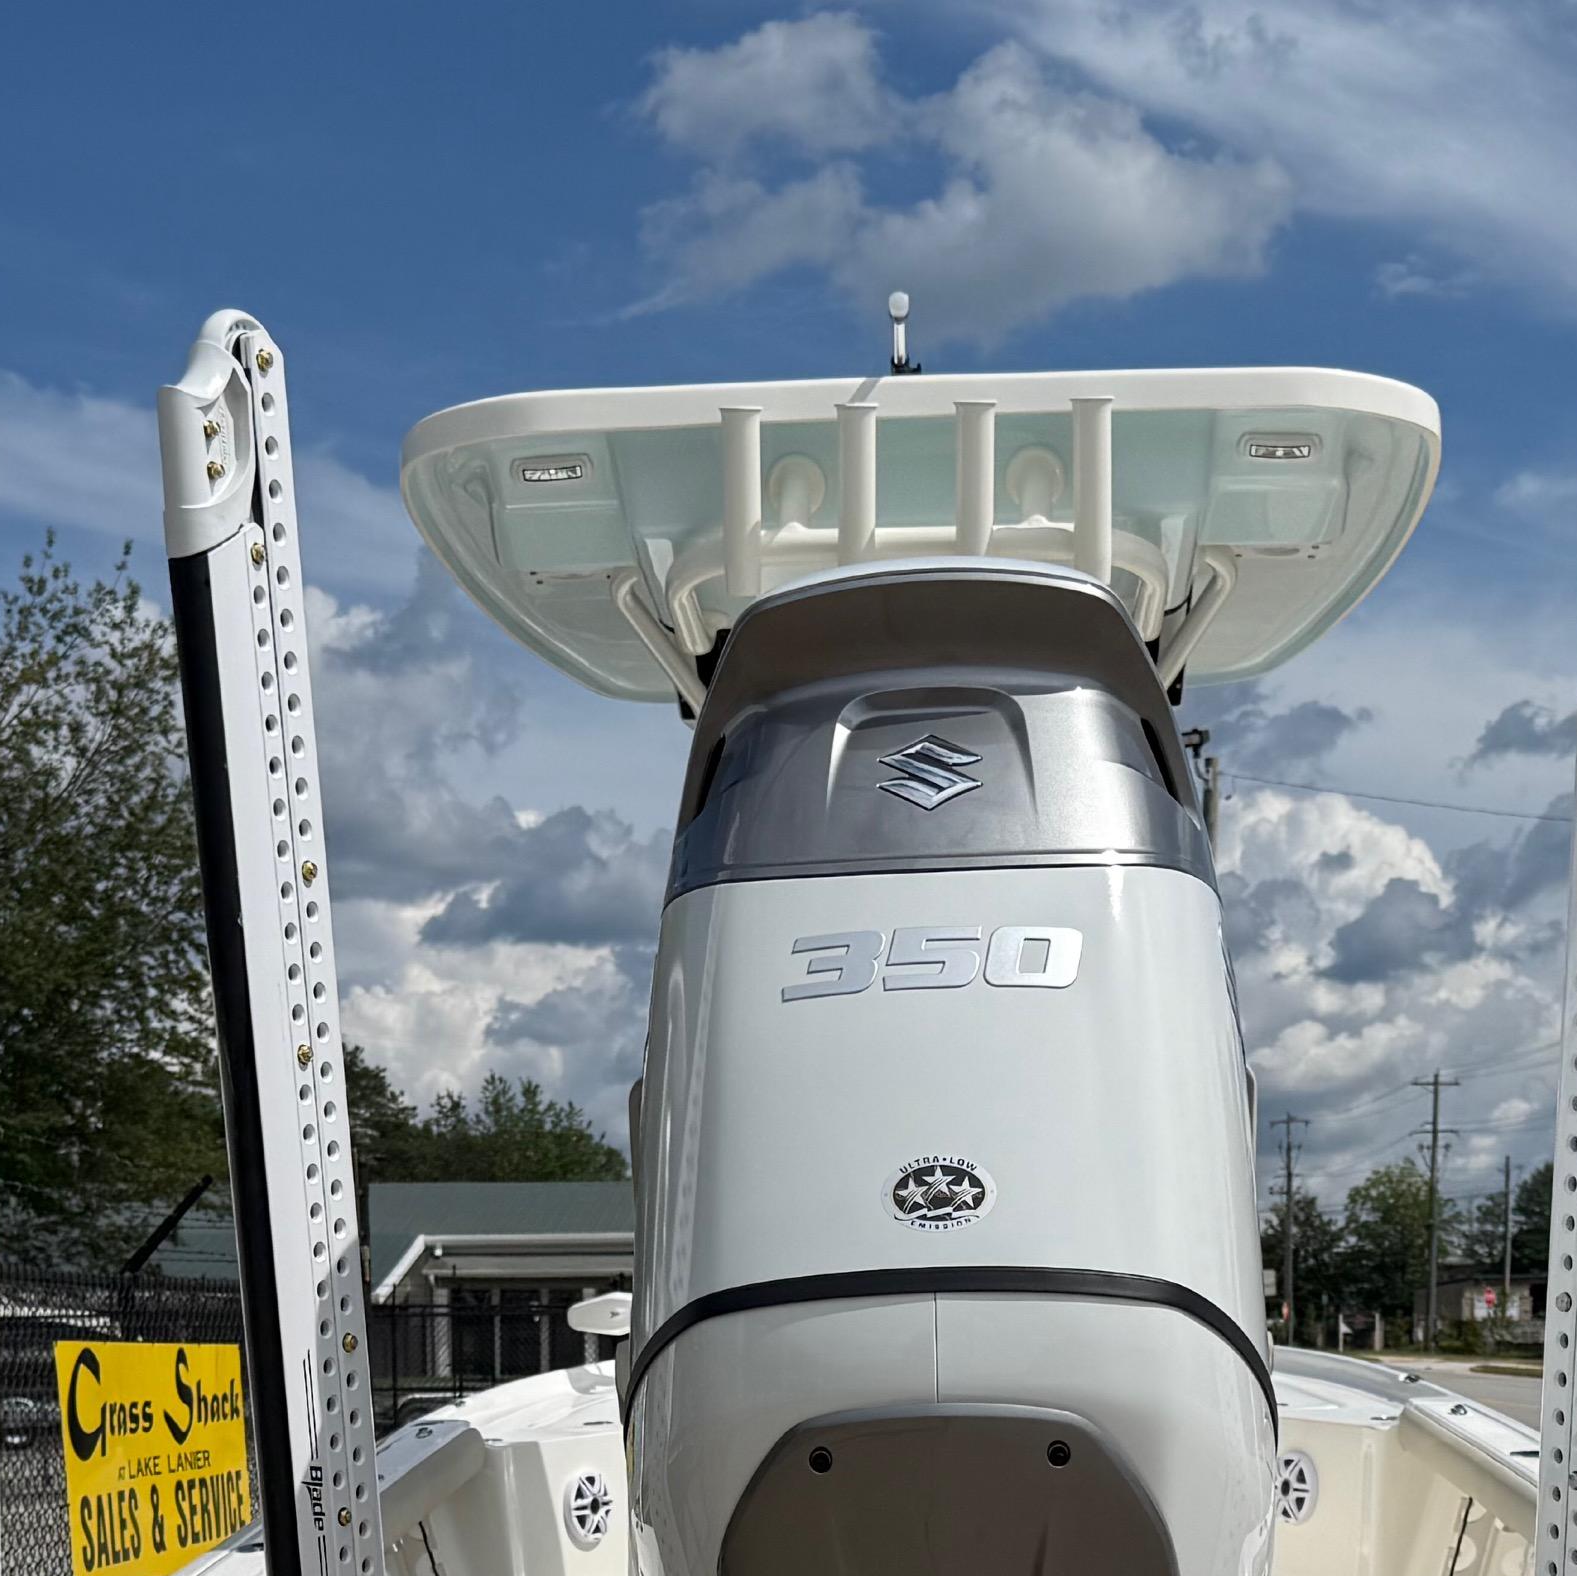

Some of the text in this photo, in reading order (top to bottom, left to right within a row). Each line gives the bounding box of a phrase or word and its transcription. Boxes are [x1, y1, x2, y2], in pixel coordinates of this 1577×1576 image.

[781, 925, 1084, 1003] 350
[910, 1217, 972, 1231] EMISSION
[67, 1347, 241, 1462] Grass Shack
[128, 1455, 162, 1480] LAKE
[168, 1450, 211, 1474] LANIER
[301, 1466, 326, 1532] Blade
[80, 1469, 246, 1573] SALES & SERVICE
